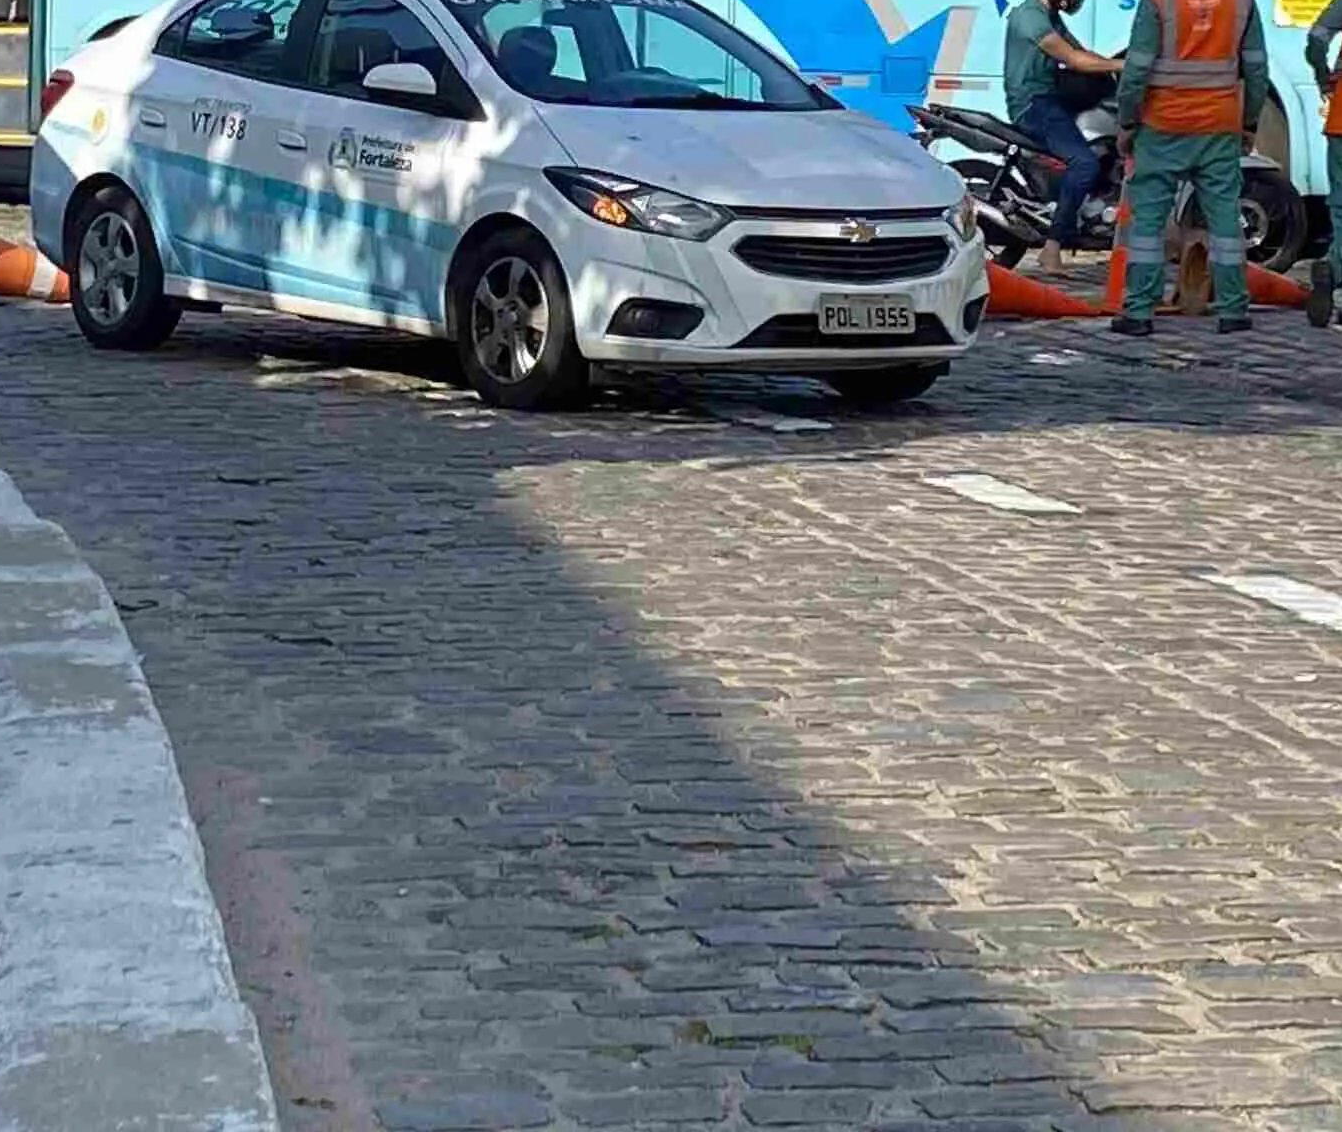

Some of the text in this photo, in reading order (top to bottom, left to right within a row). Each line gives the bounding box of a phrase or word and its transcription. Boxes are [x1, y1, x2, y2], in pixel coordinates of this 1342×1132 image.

[192, 111, 247, 140] VT/138
[360, 149, 412, 172] Fortaleza
[866, 306, 908, 327] 1955
